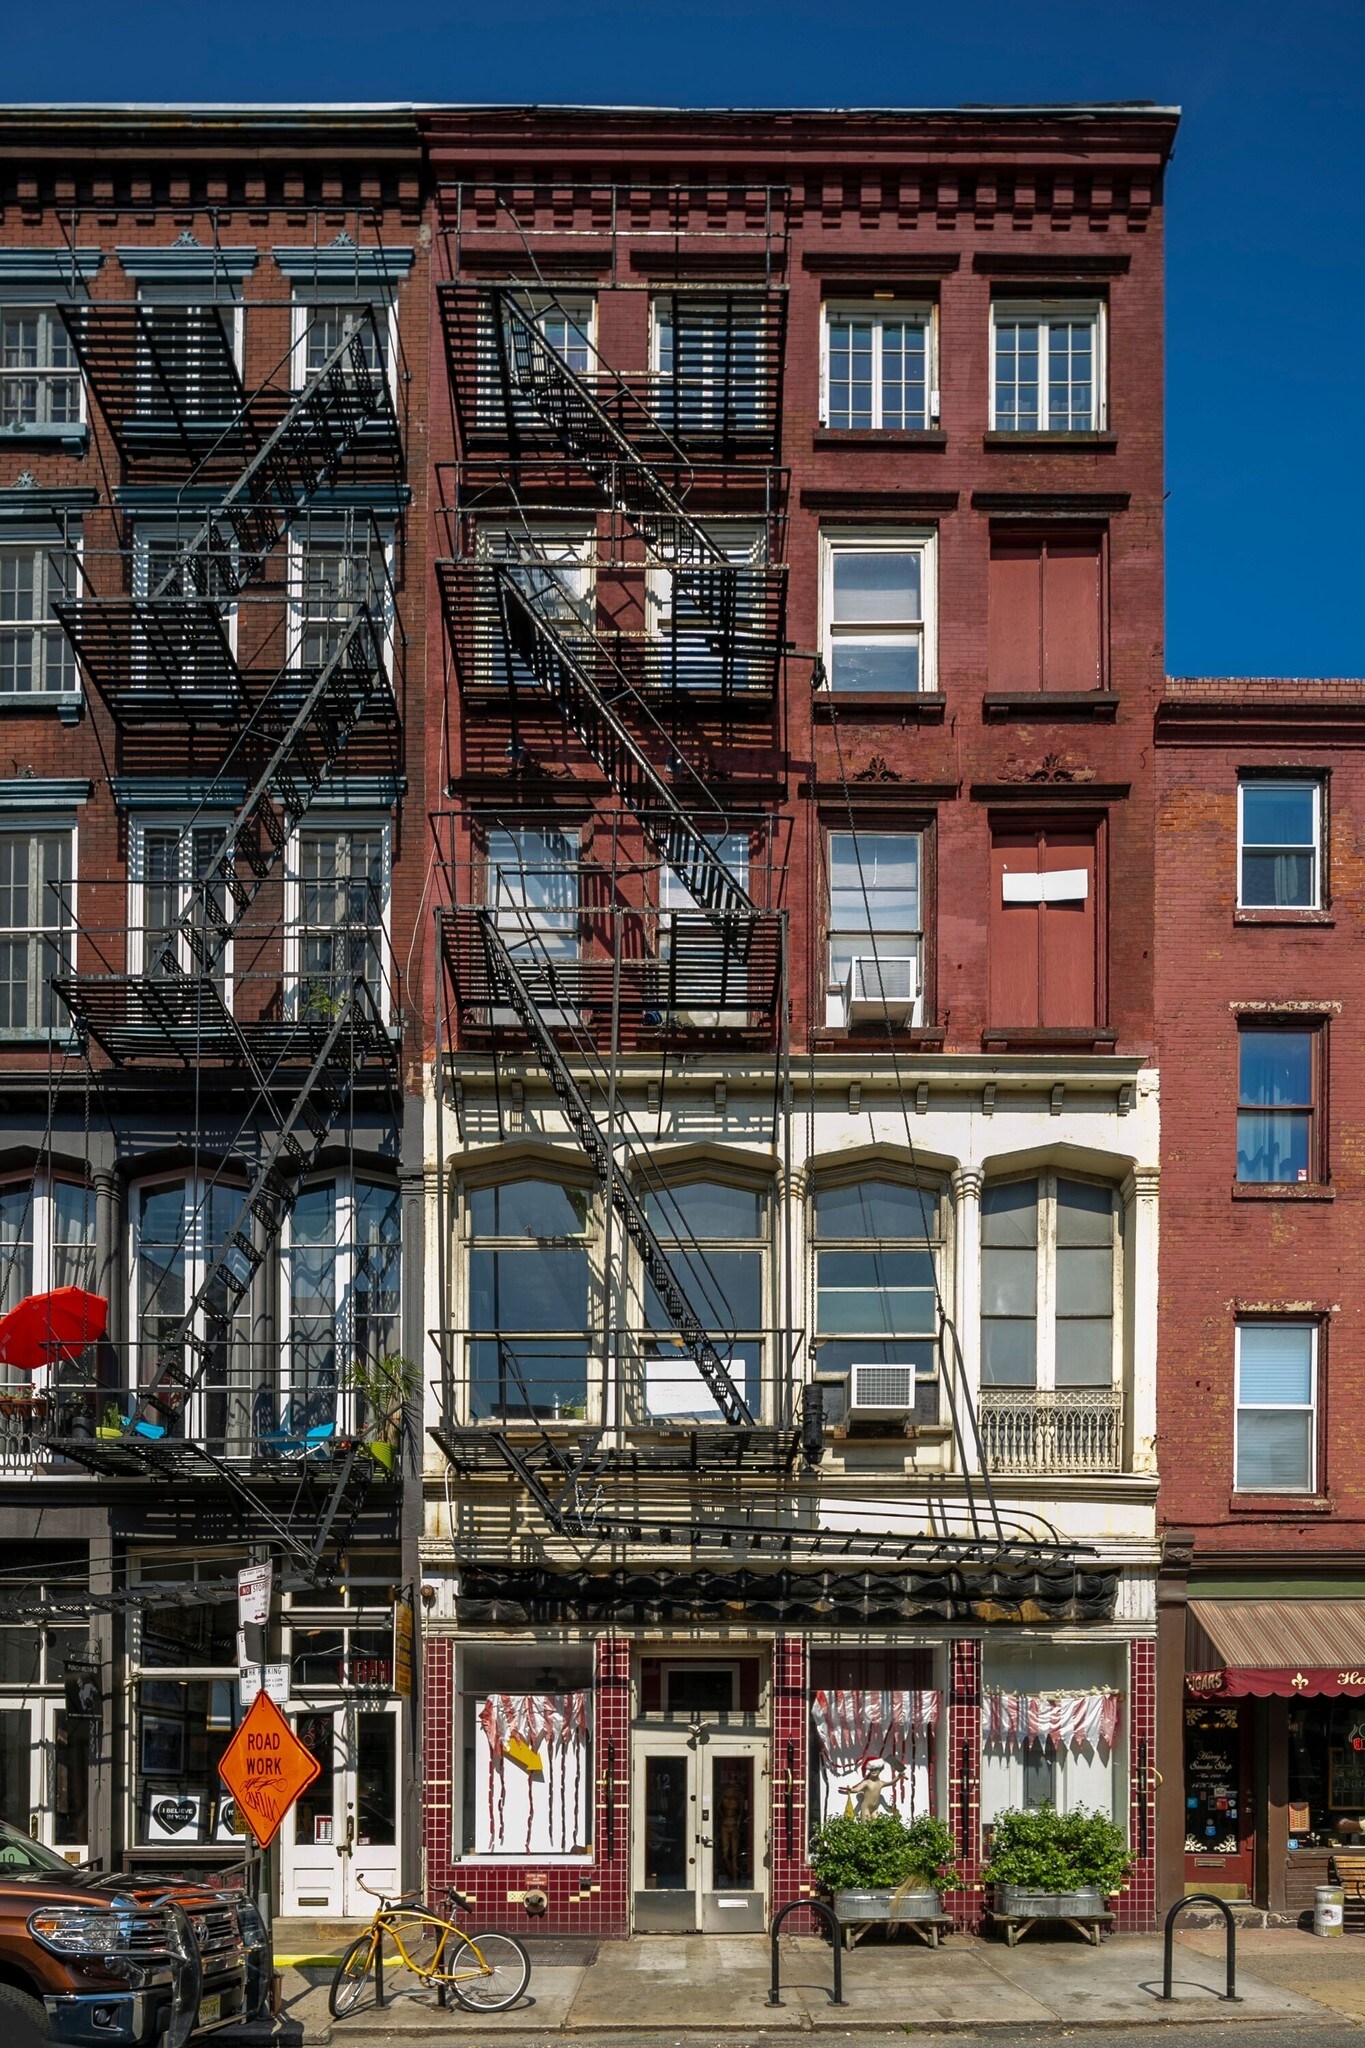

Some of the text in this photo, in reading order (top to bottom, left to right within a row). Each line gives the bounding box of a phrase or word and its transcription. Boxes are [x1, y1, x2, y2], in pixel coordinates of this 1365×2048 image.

[247, 1733, 280, 1750] ROAD
[246, 1758, 282, 1775] WORK
[1190, 1761, 1232, 1773] Smoke Shop
